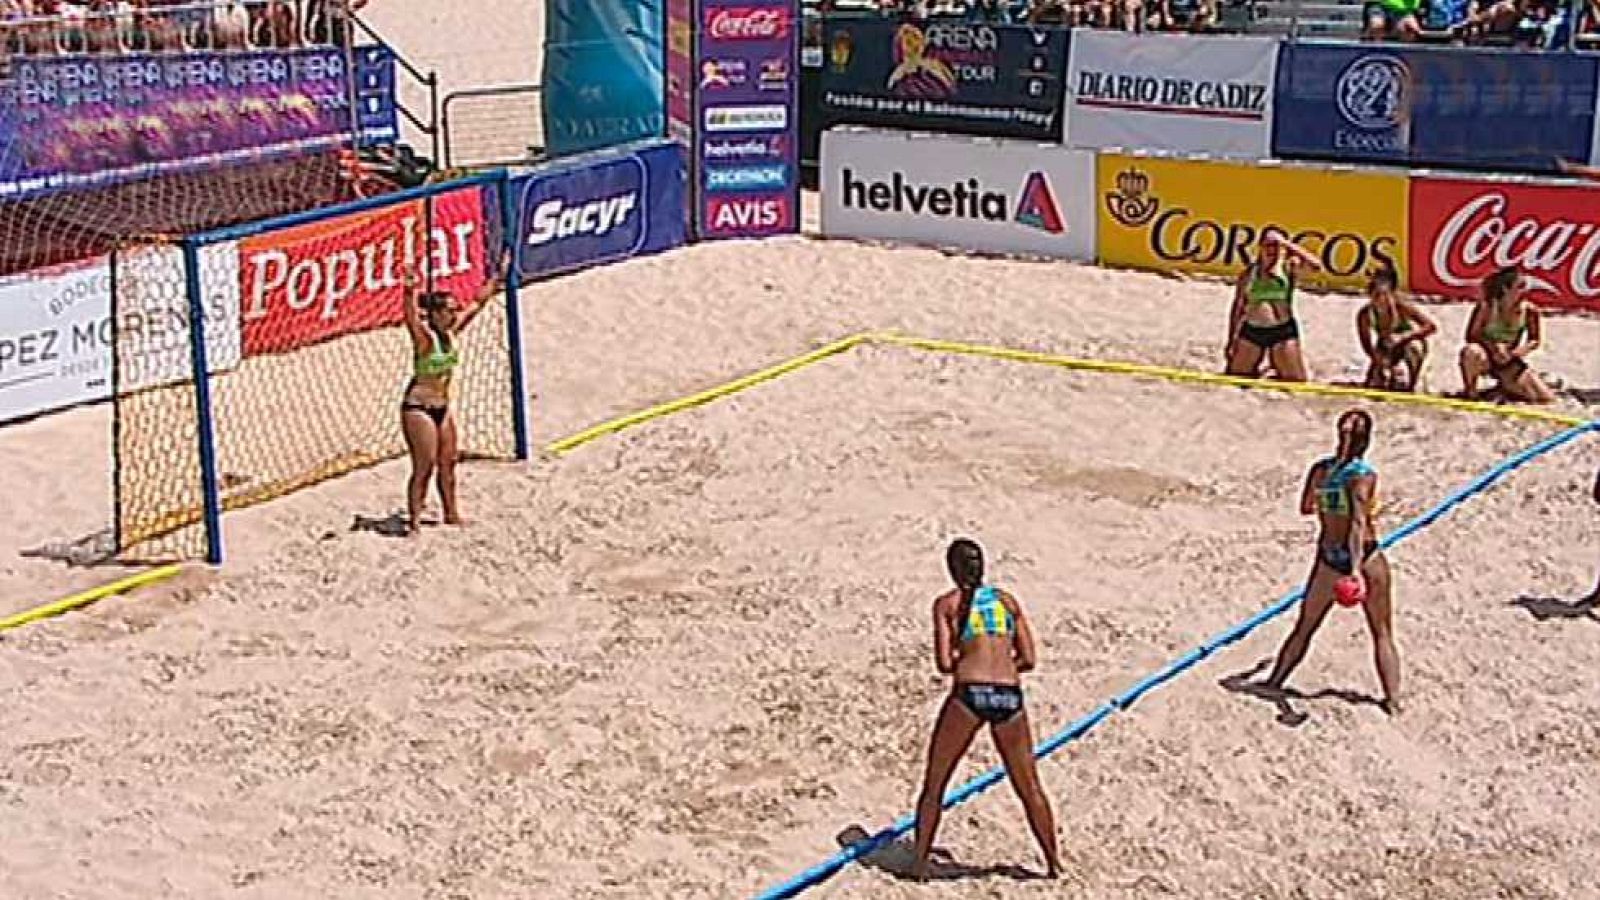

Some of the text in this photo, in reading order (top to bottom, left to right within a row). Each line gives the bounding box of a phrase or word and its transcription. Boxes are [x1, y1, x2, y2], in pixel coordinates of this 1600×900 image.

[926, 25, 998, 50] ARENA
[951, 64, 996, 80] TOUR
[1079, 70, 1266, 111] DIARIO DE CADIZ
[527, 191, 637, 245] Sacyr
[714, 199, 778, 228] AVIS
[842, 168, 1008, 222] helvetia
[243, 215, 475, 320] Popular
[1151, 208, 1397, 277] COROS
[1432, 193, 1600, 296] Coca-C
[71, 292, 227, 353] MORENS
